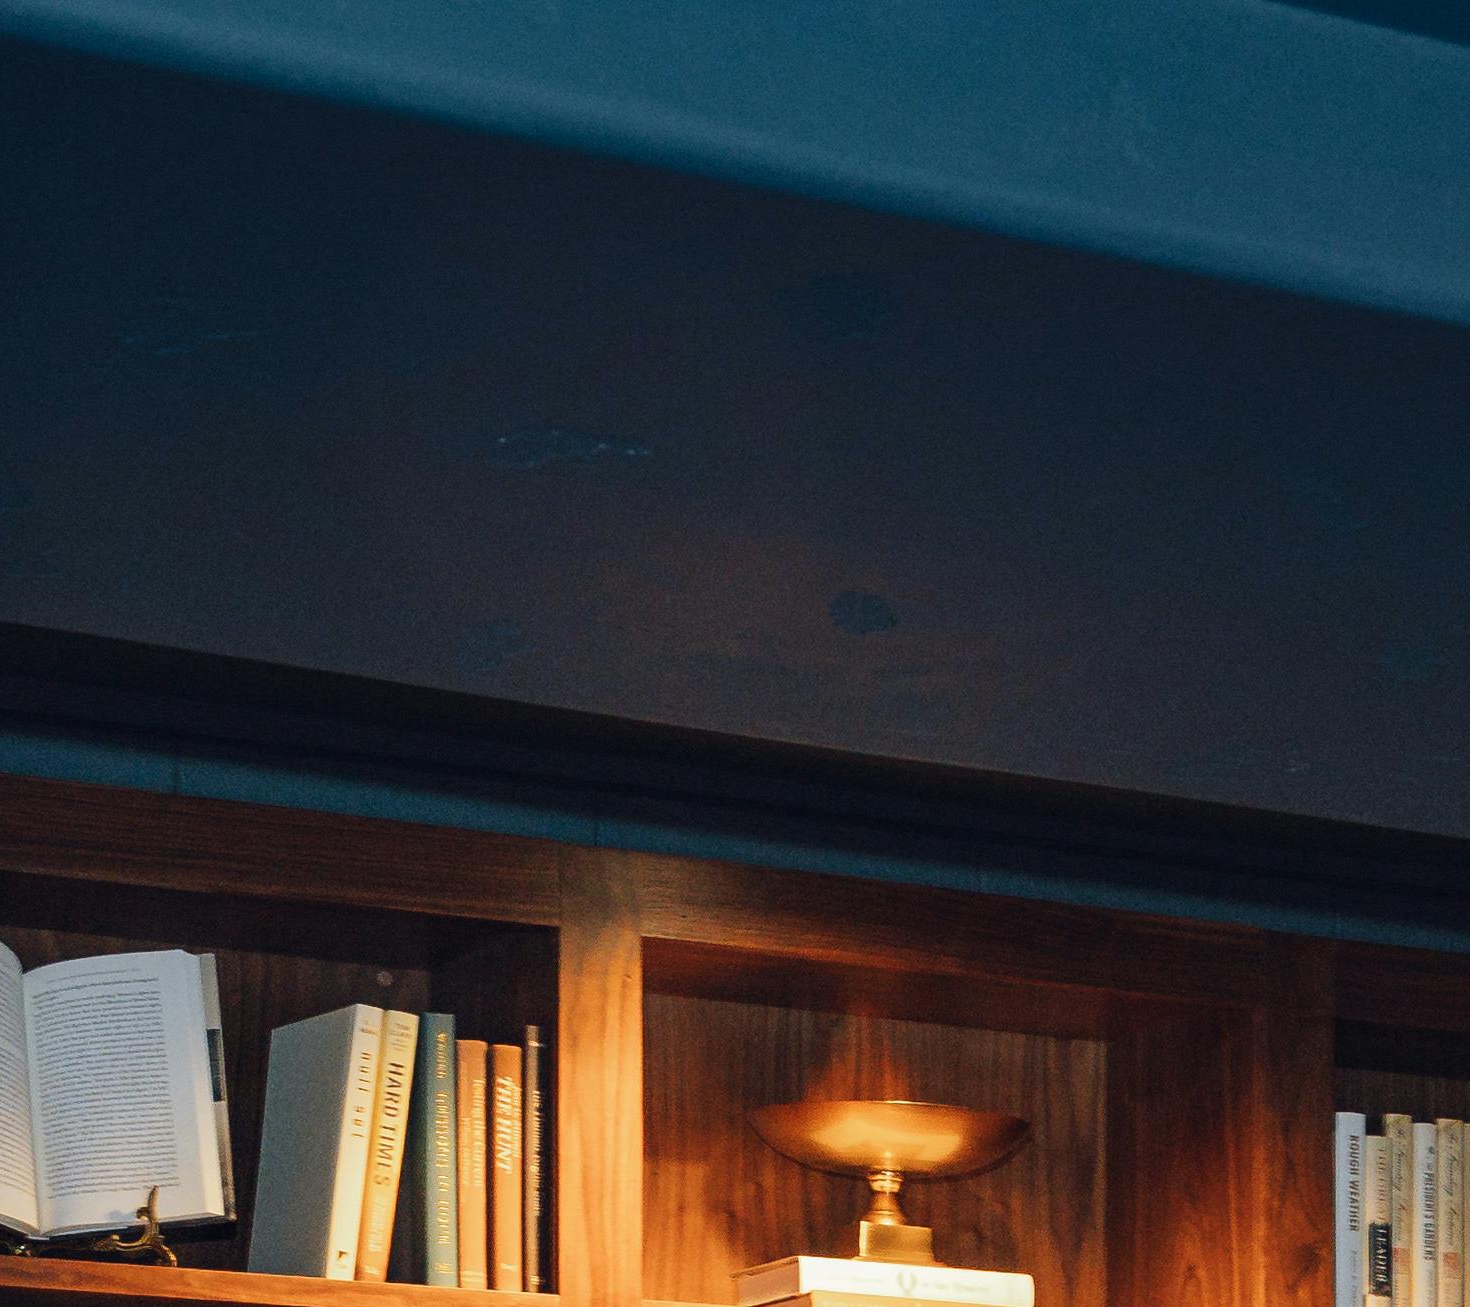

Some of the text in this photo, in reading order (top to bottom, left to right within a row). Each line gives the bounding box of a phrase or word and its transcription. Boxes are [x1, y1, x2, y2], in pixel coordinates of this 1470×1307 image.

[383, 1062, 403, 1117] HARD
[1350, 1135, 1359, 1231] ROUGH WEATHER
